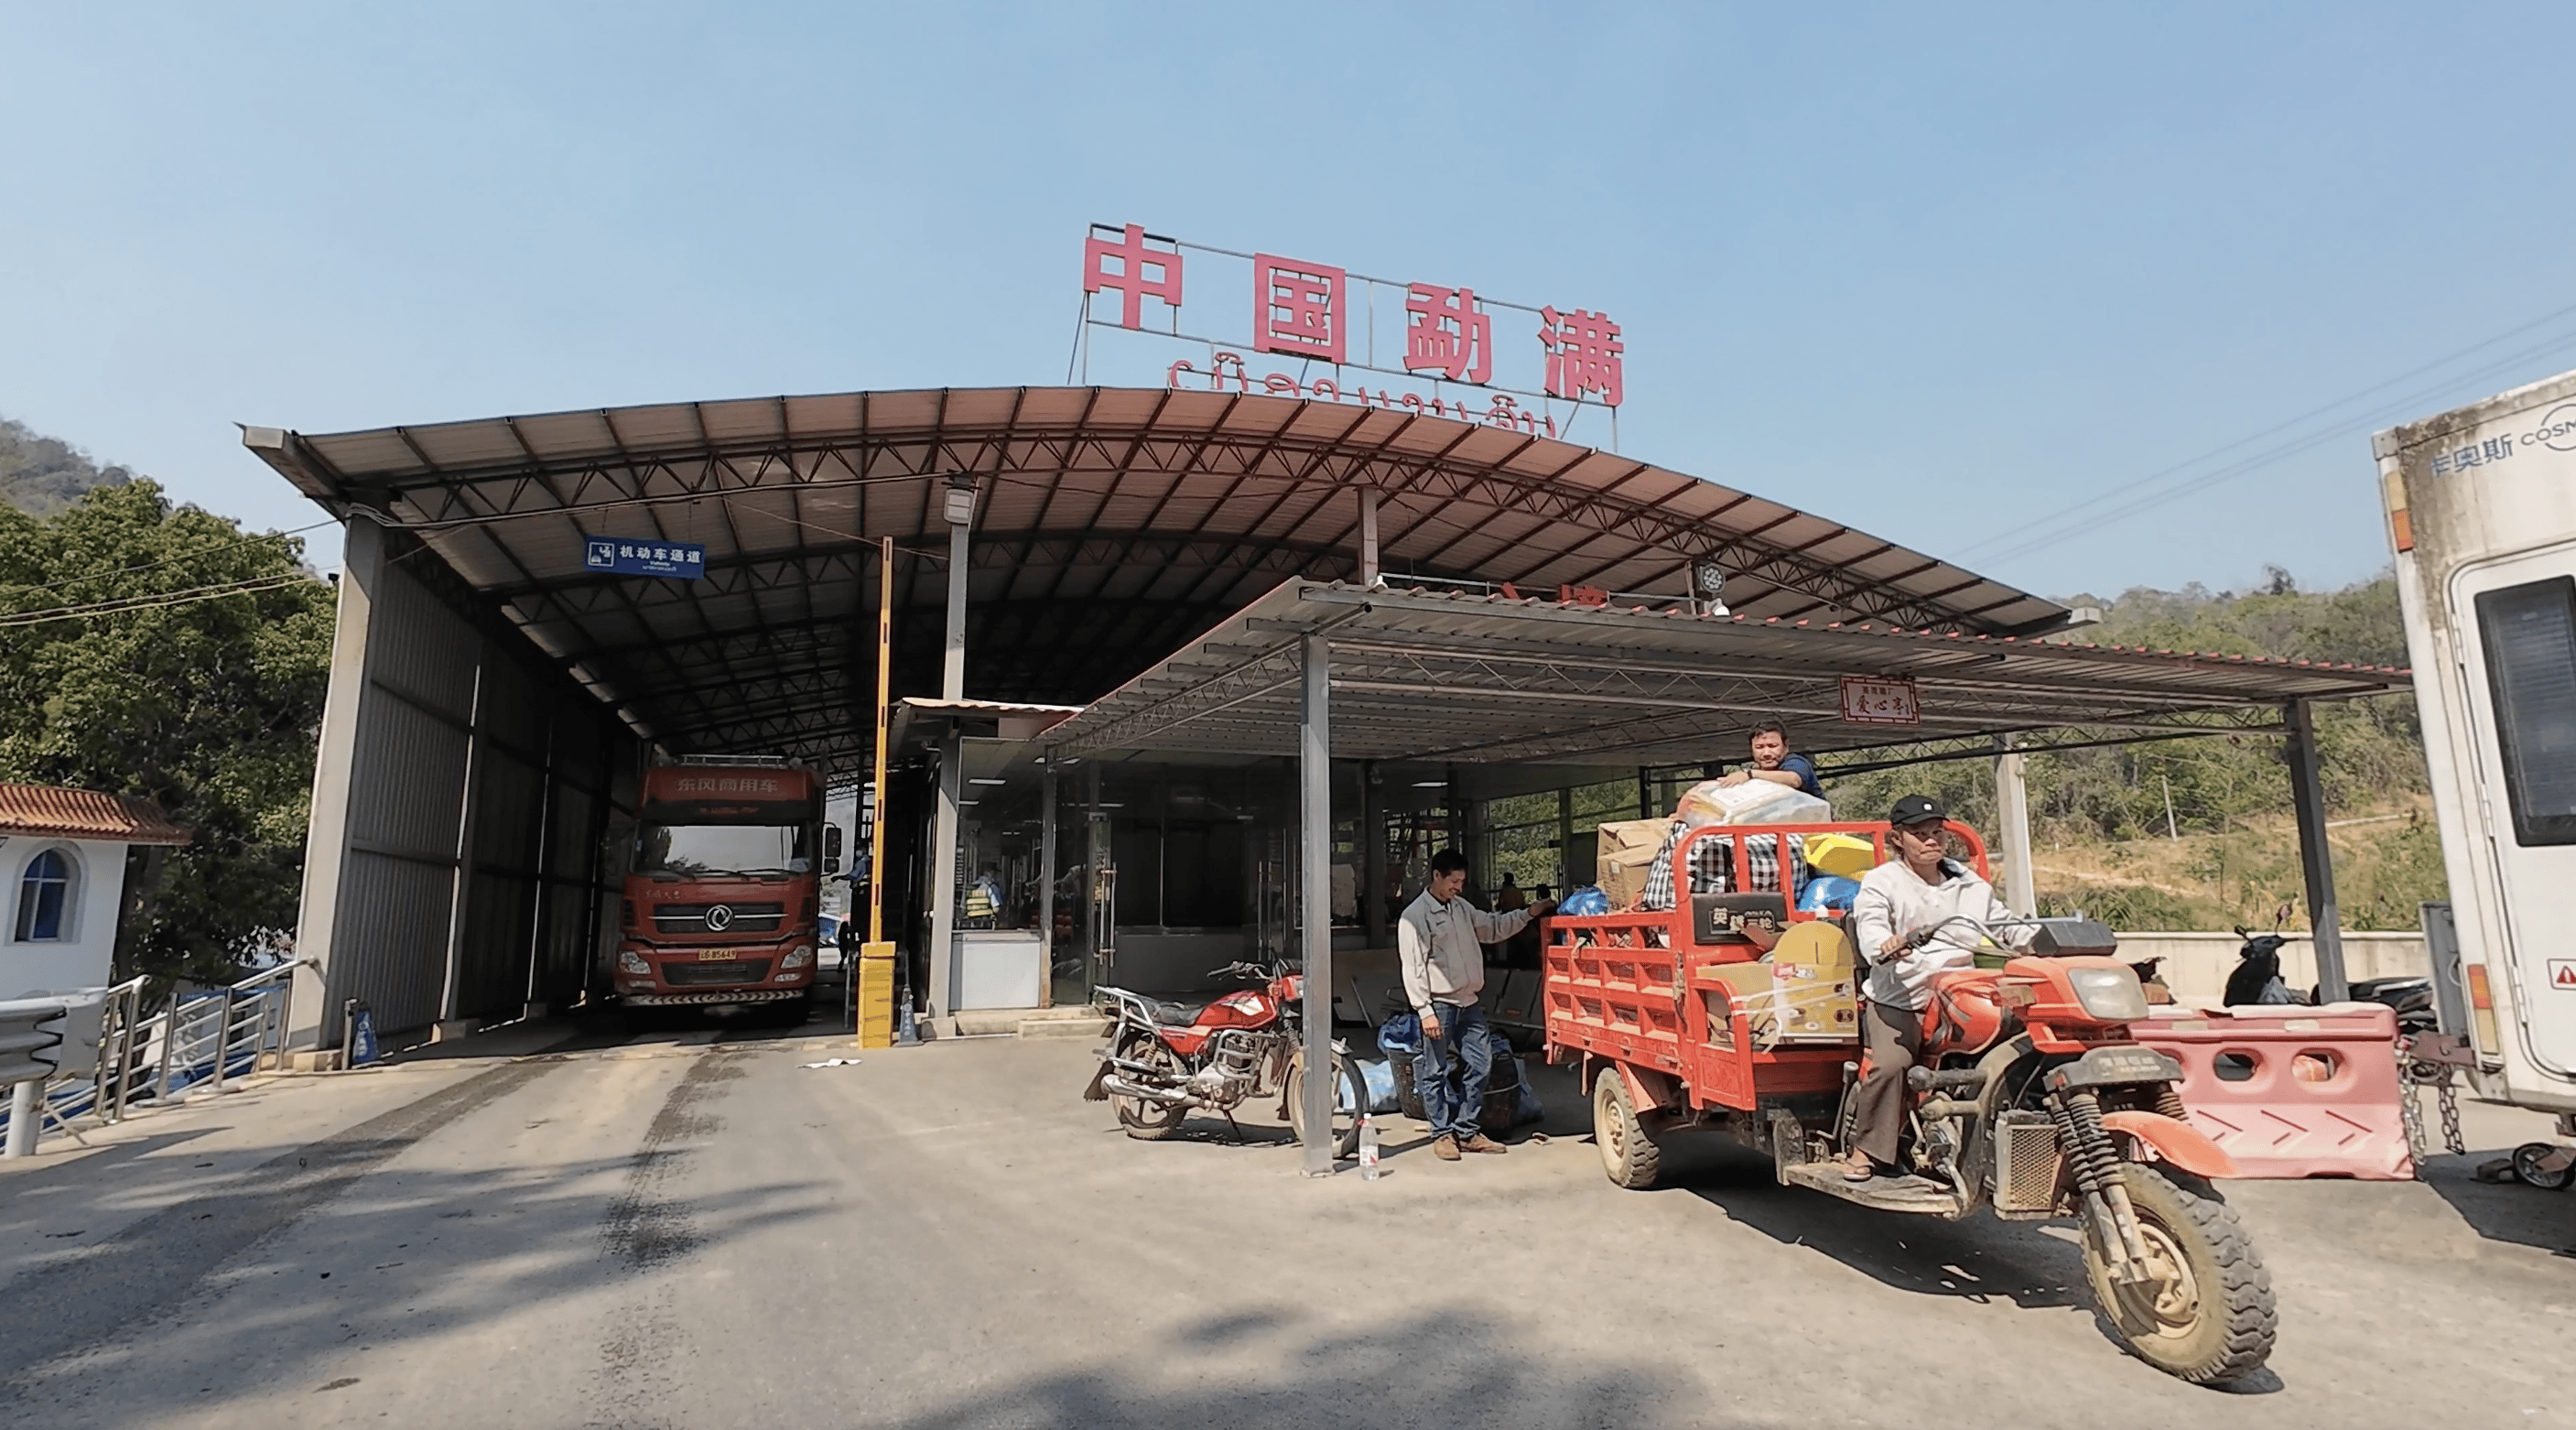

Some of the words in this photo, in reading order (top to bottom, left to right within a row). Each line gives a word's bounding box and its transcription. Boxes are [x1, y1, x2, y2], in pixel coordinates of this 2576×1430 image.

[1084, 223, 1624, 406] 中国勐满
[2431, 433, 2514, 477] 卡奥斯
[620, 545, 701, 563] 机动车通道
[677, 777, 778, 793] 东风商用车
